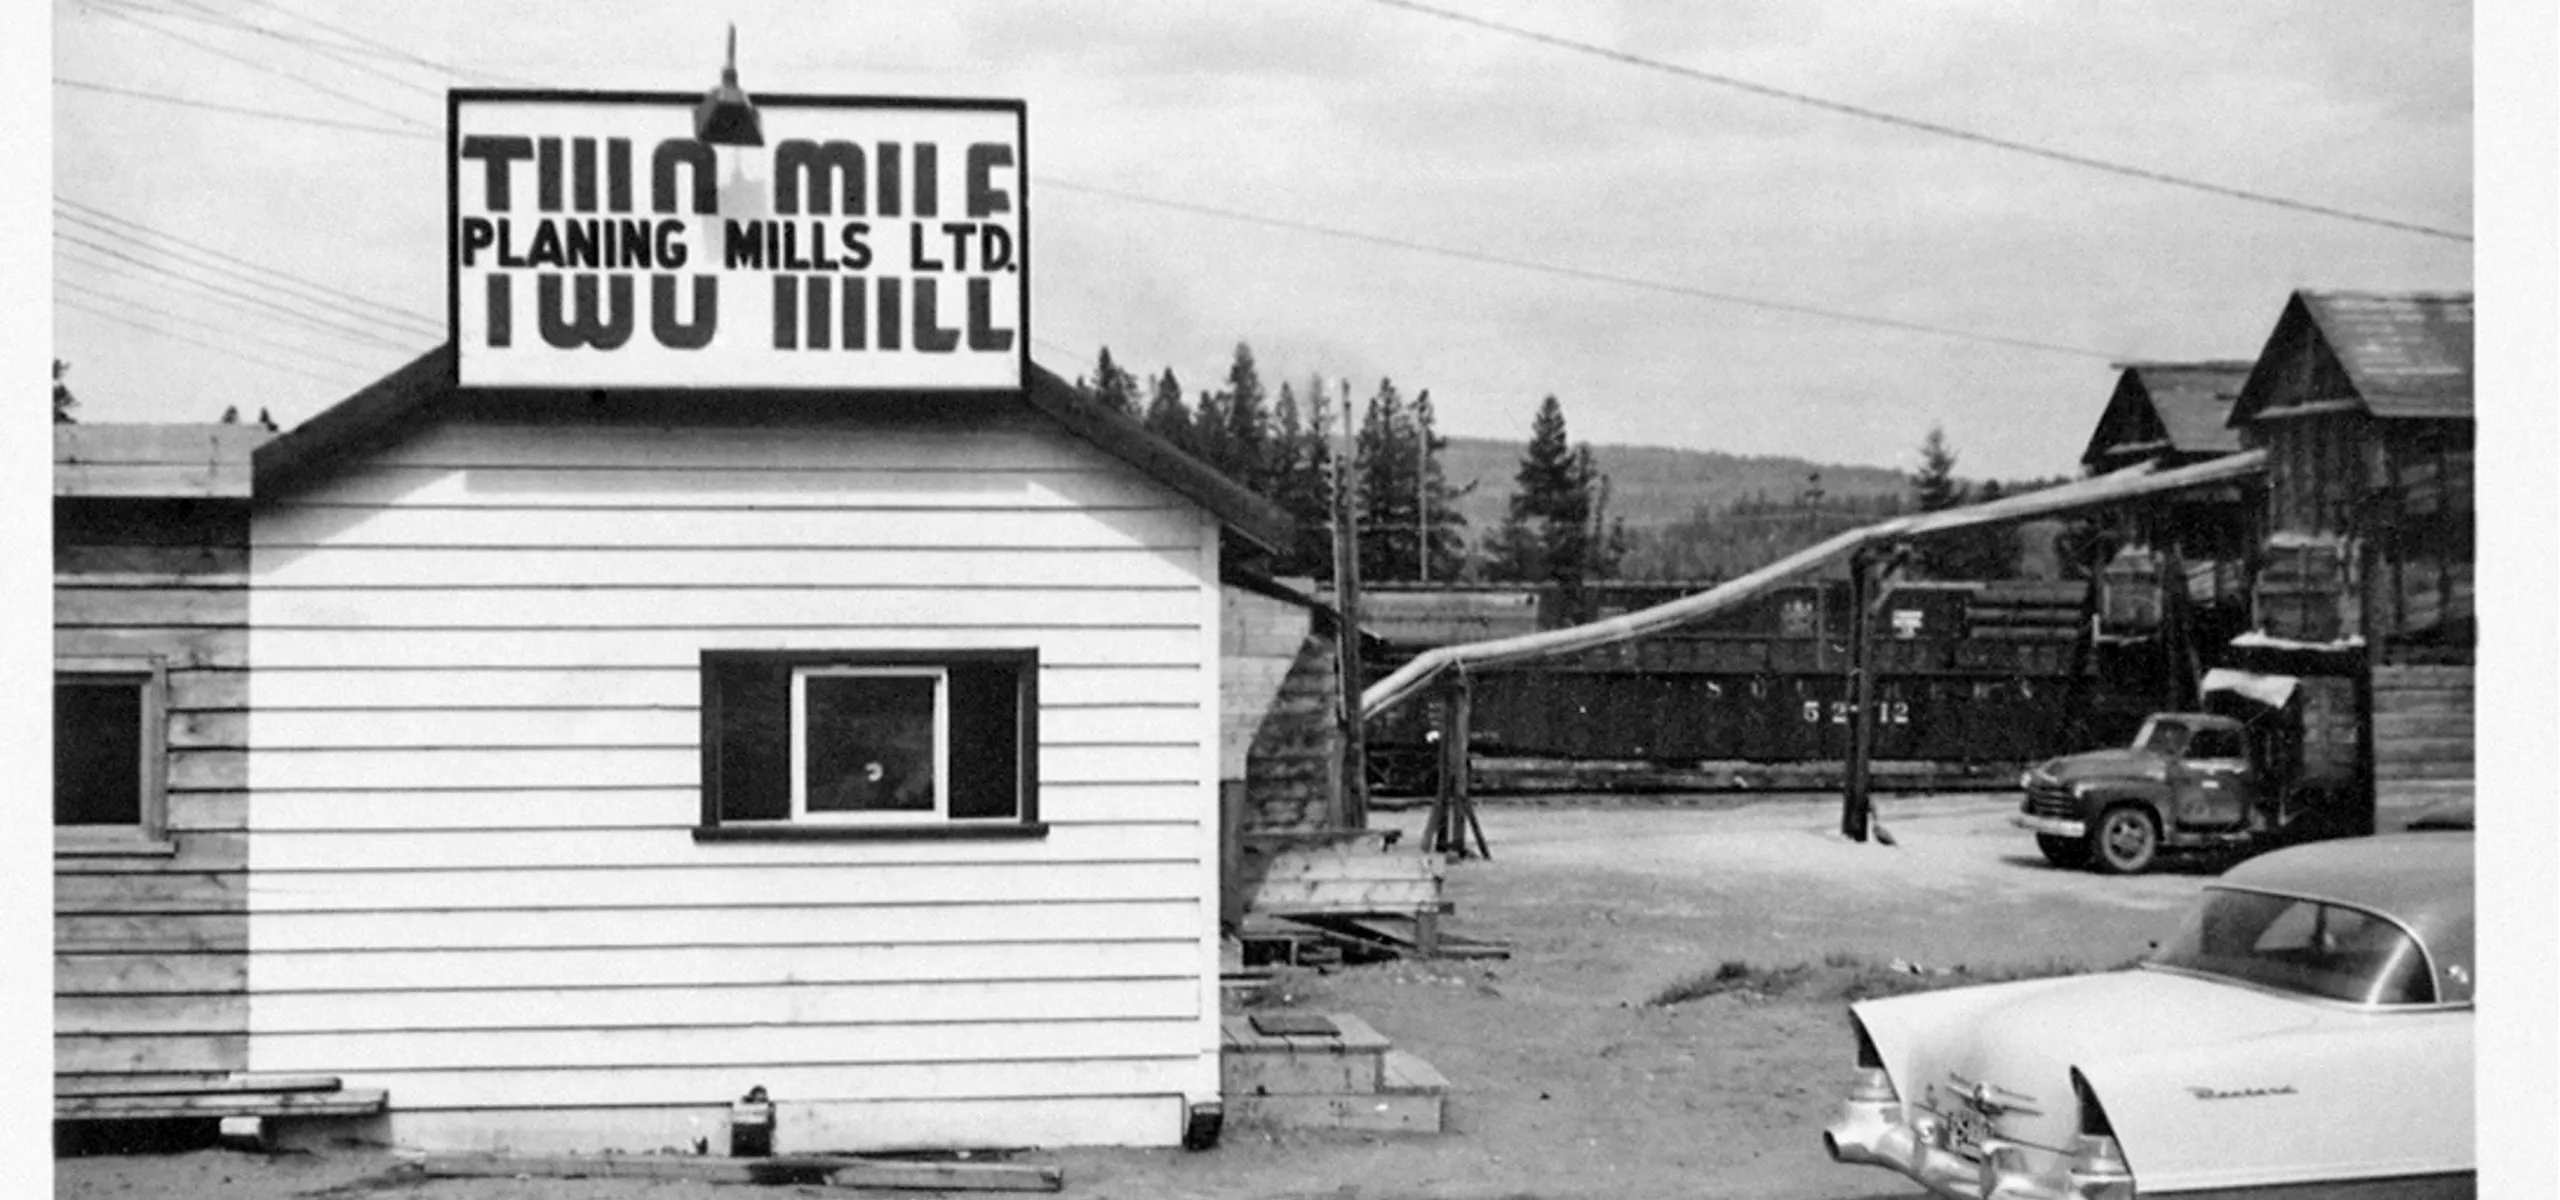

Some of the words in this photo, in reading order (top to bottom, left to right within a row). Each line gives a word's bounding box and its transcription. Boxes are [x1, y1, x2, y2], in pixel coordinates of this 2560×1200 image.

[461, 216, 688, 270] PLANING
[724, 218, 873, 271] MILLS
[910, 221, 1018, 274] LTD.
